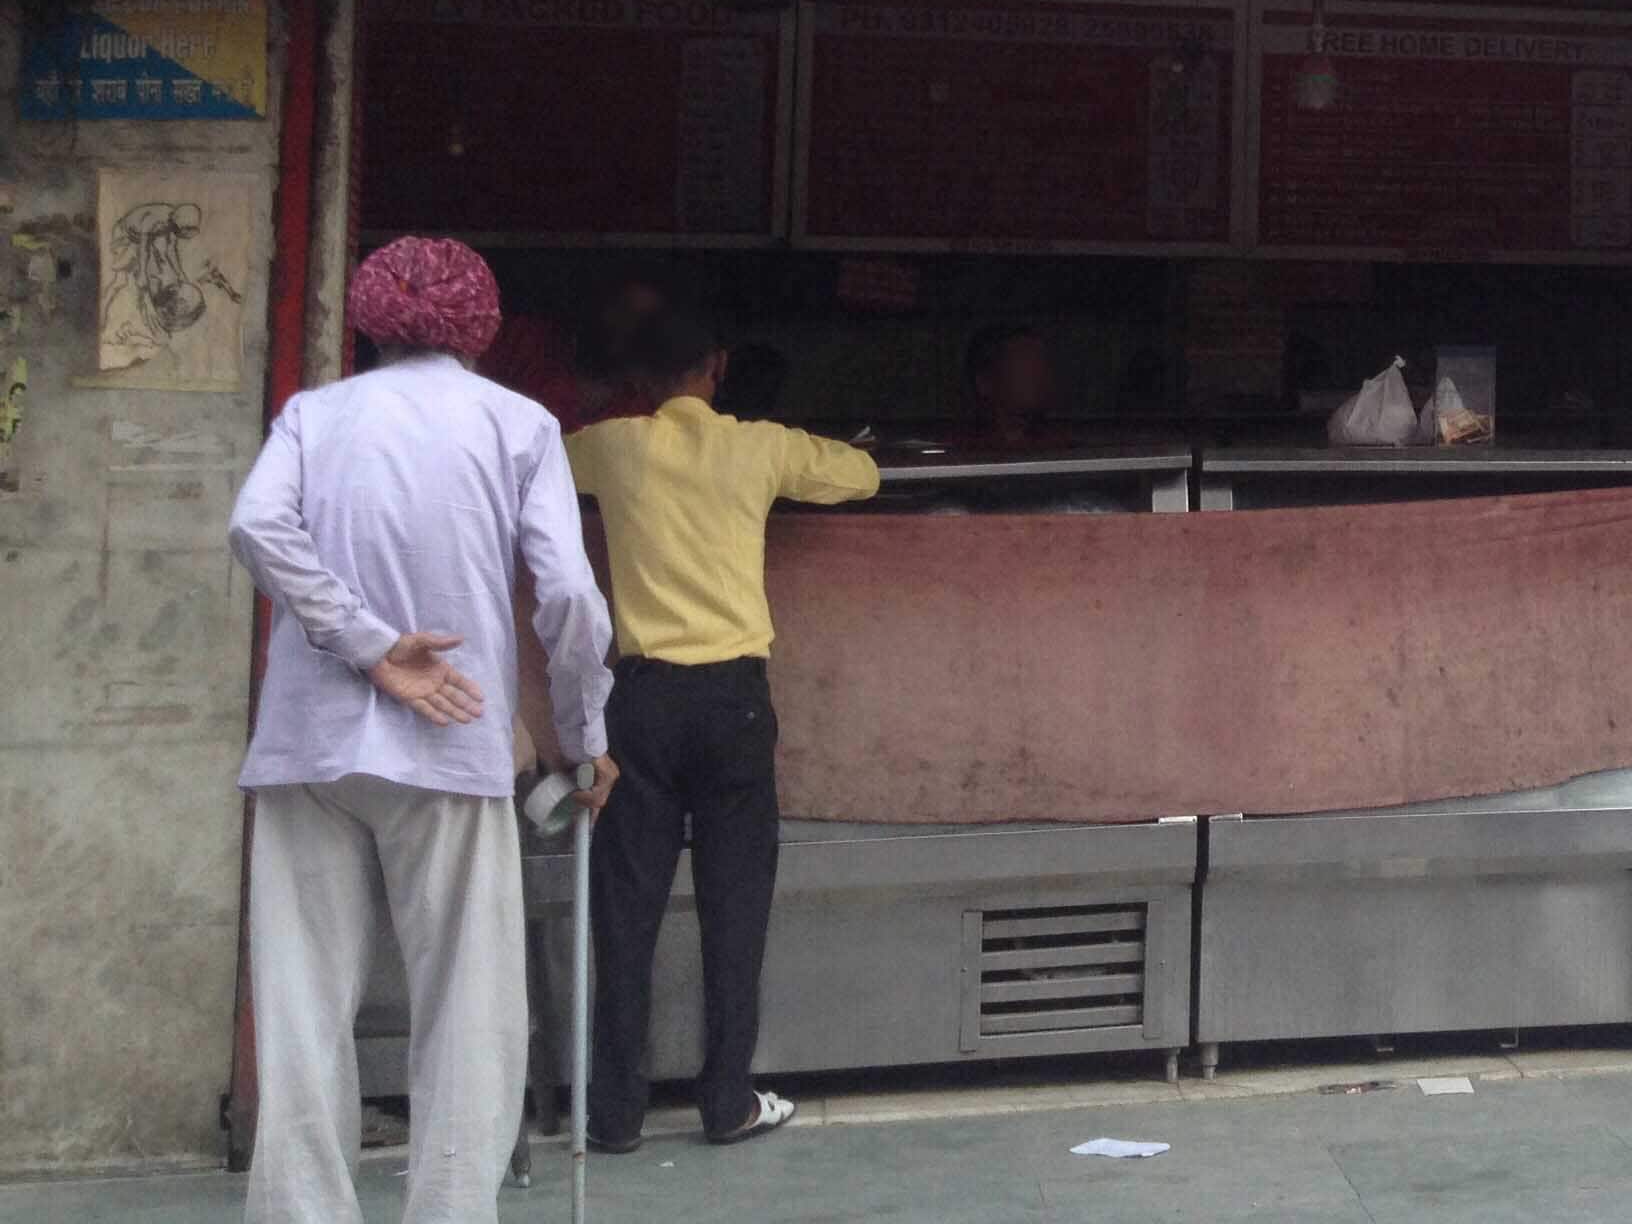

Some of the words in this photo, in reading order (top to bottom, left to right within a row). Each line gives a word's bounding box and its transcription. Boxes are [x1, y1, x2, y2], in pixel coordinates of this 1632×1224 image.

[80, 32, 148, 64] Liquor
[1381, 30, 1457, 57] HOME
[1465, 34, 1585, 62] DELIVERY
